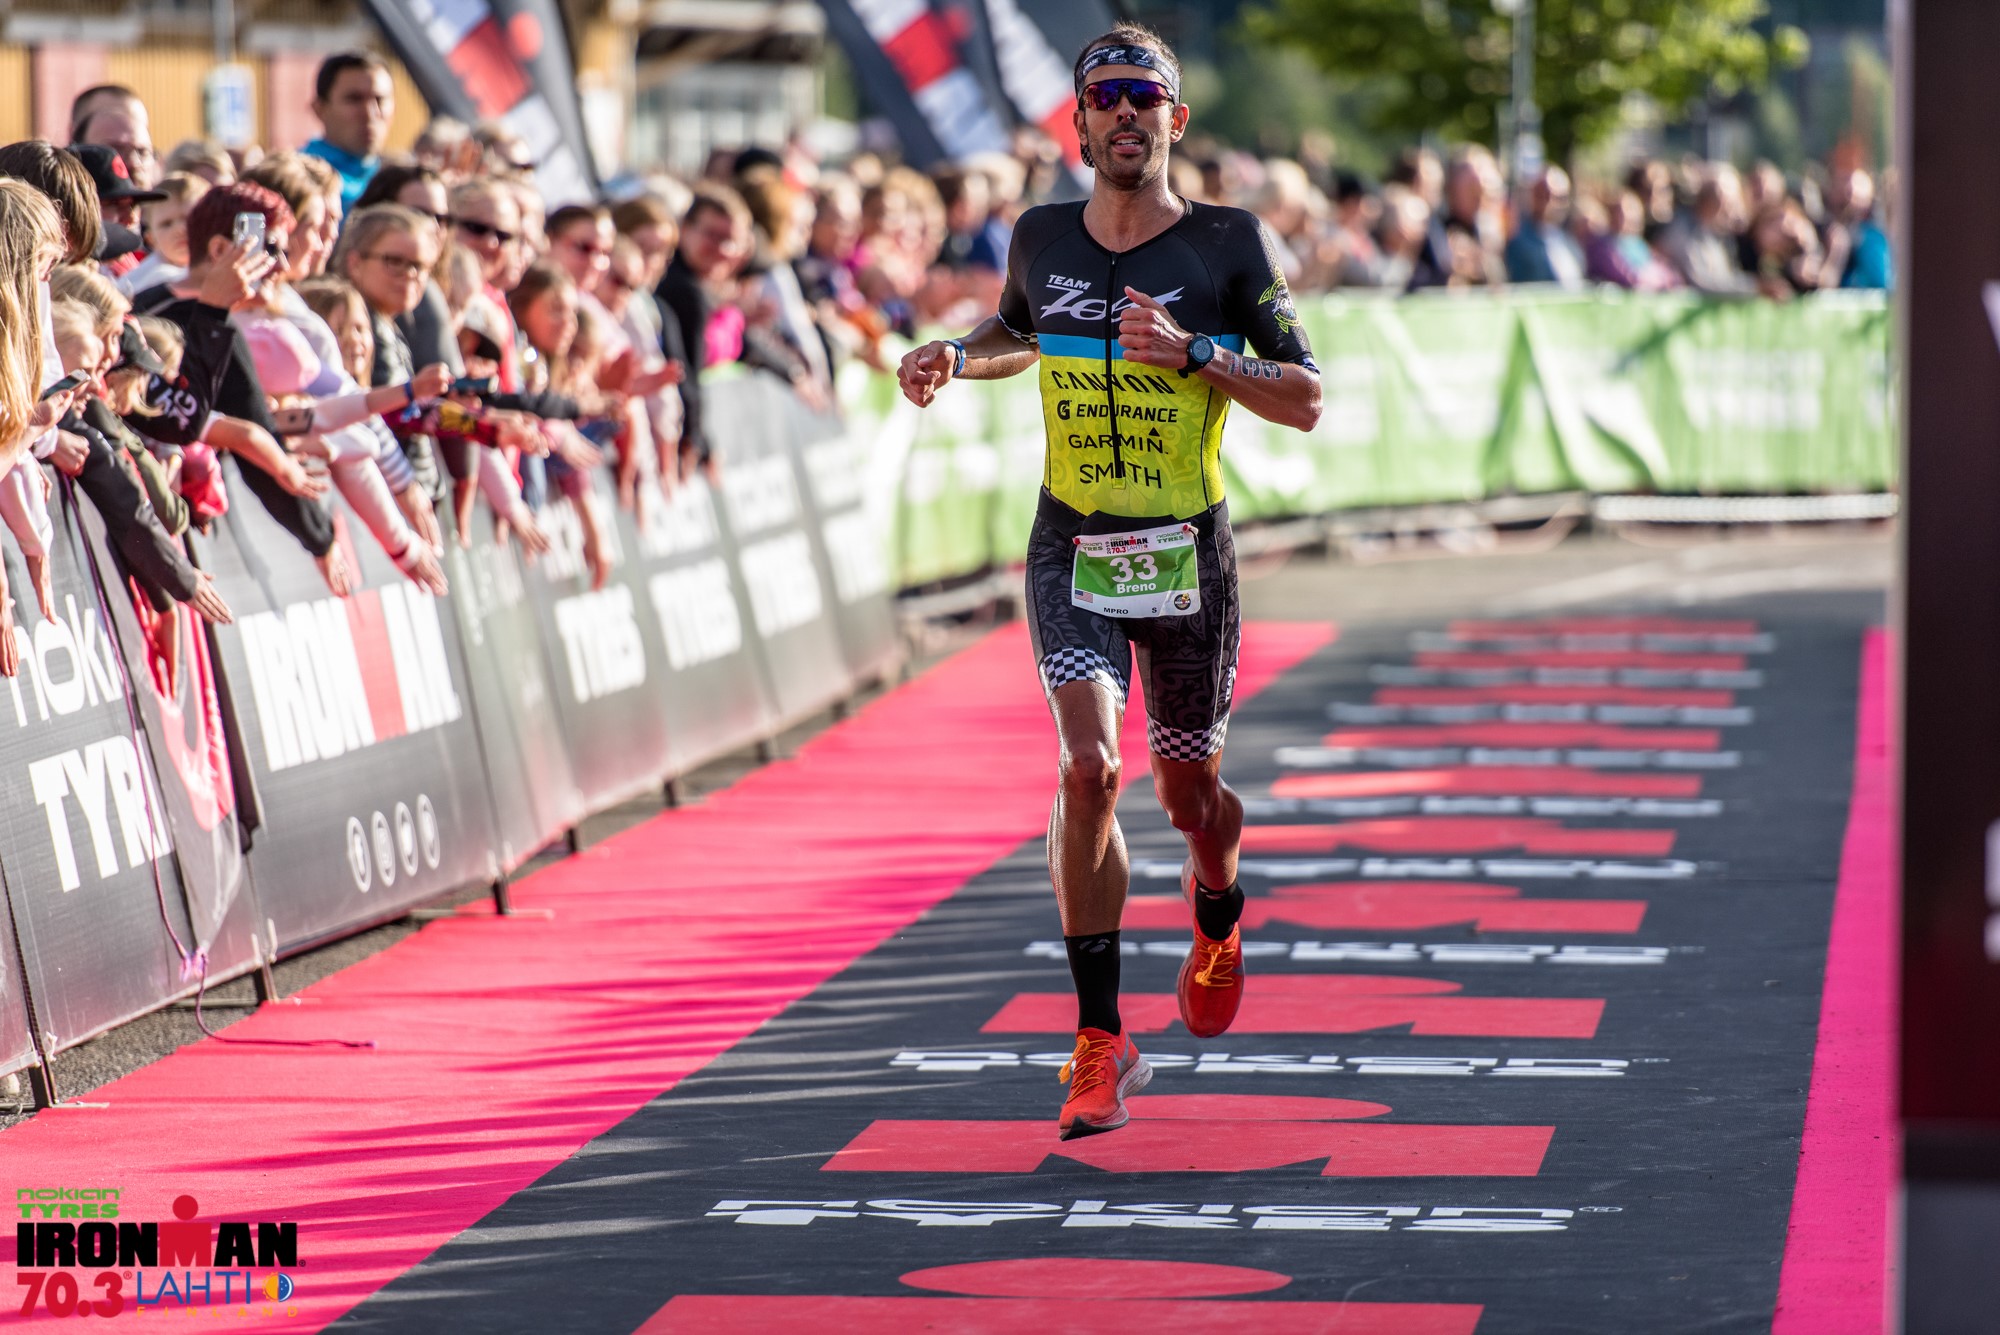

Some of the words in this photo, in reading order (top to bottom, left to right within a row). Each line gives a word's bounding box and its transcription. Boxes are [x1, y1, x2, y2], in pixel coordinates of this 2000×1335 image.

[1049, 274, 1091, 291] TEAM
[1051, 370, 1177, 395] CANYON
[1076, 403, 1179, 423] ENDURANCE
[1068, 433, 1165, 454] GARMIN
[1079, 460, 1162, 489] SMITH
[1110, 537, 1149, 548] IRONMAN
[1109, 554, 1159, 583] 33
[1116, 582, 1157, 594] Breno
[1103, 607, 1129, 615] MPRO
